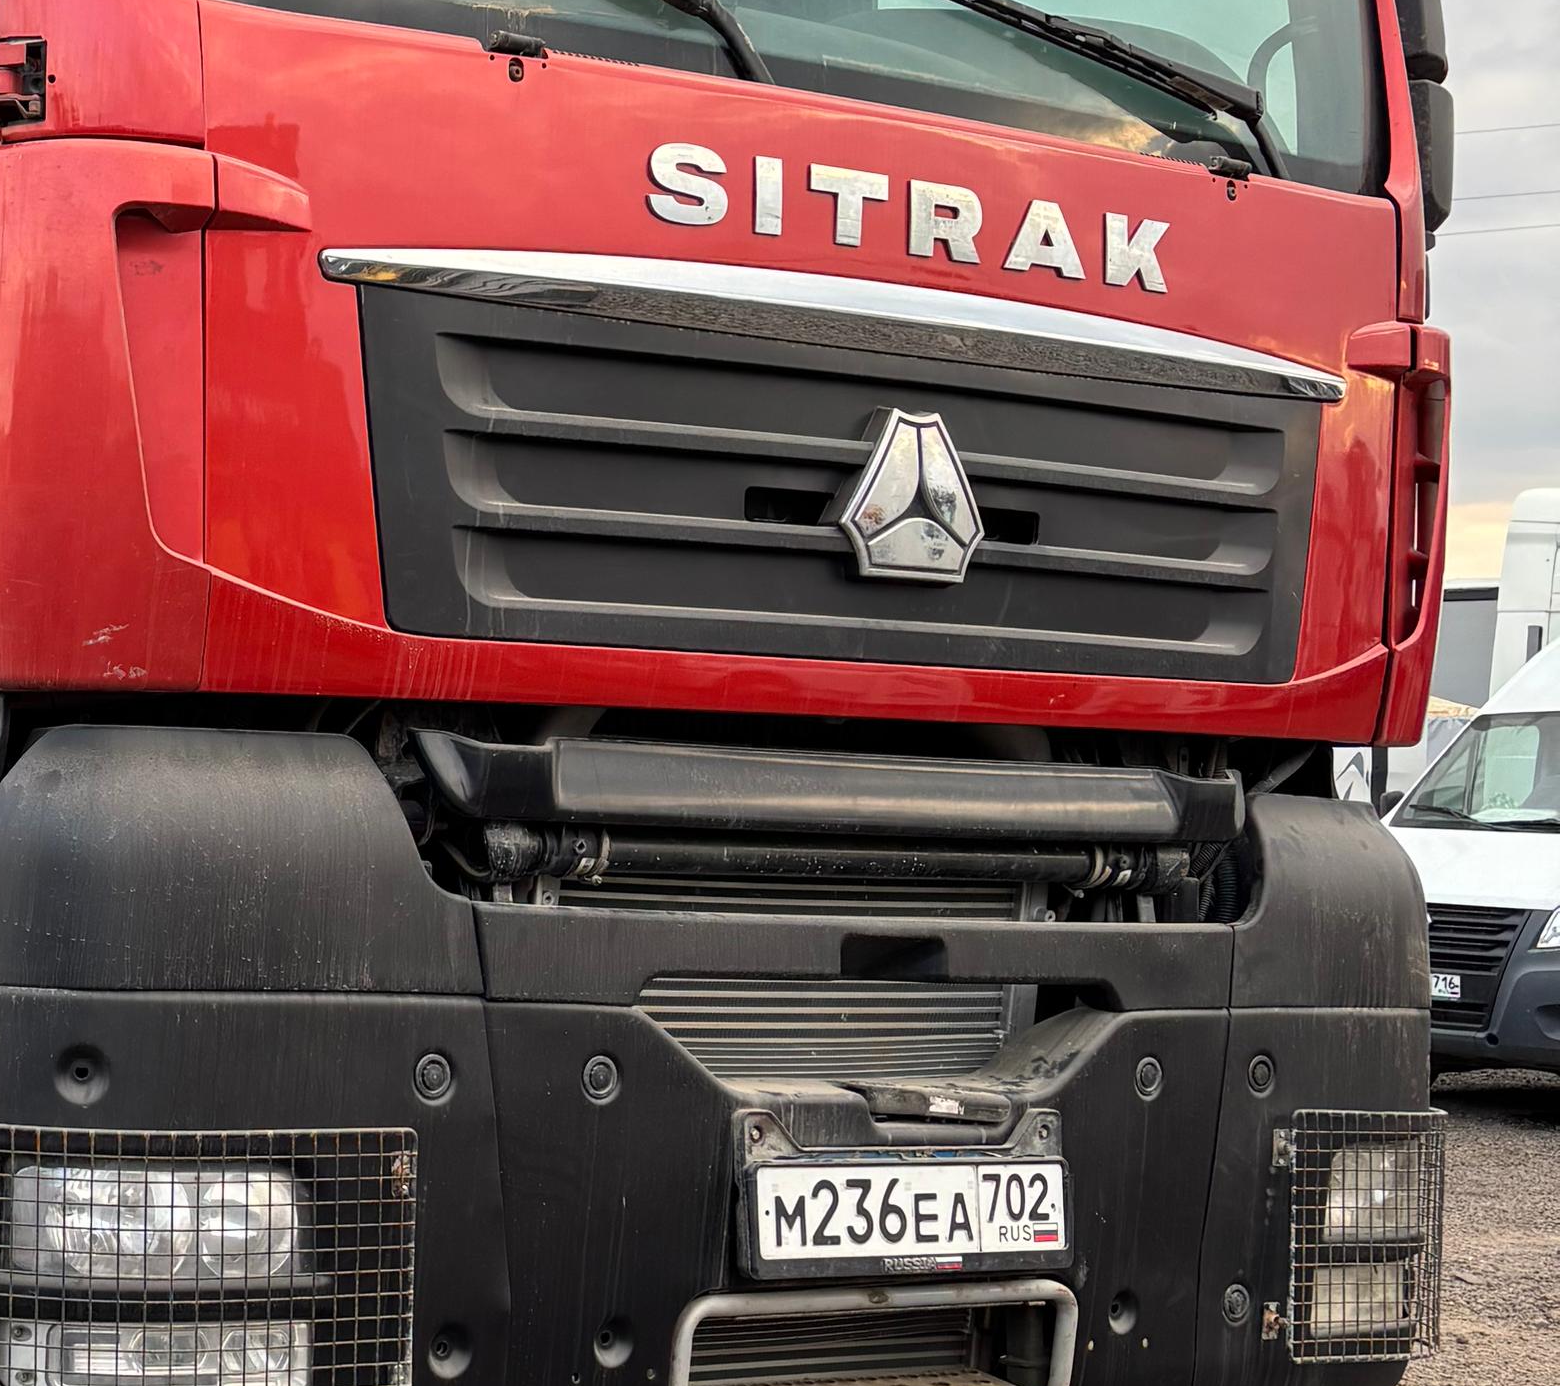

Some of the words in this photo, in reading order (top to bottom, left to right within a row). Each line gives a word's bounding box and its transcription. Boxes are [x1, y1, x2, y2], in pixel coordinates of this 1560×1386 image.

[645, 142, 1171, 294] SITRAK
[981, 1172, 1050, 1223] 702
[999, 1225, 1032, 1242] RUS
[882, 1256, 937, 1273] RUSSIA
